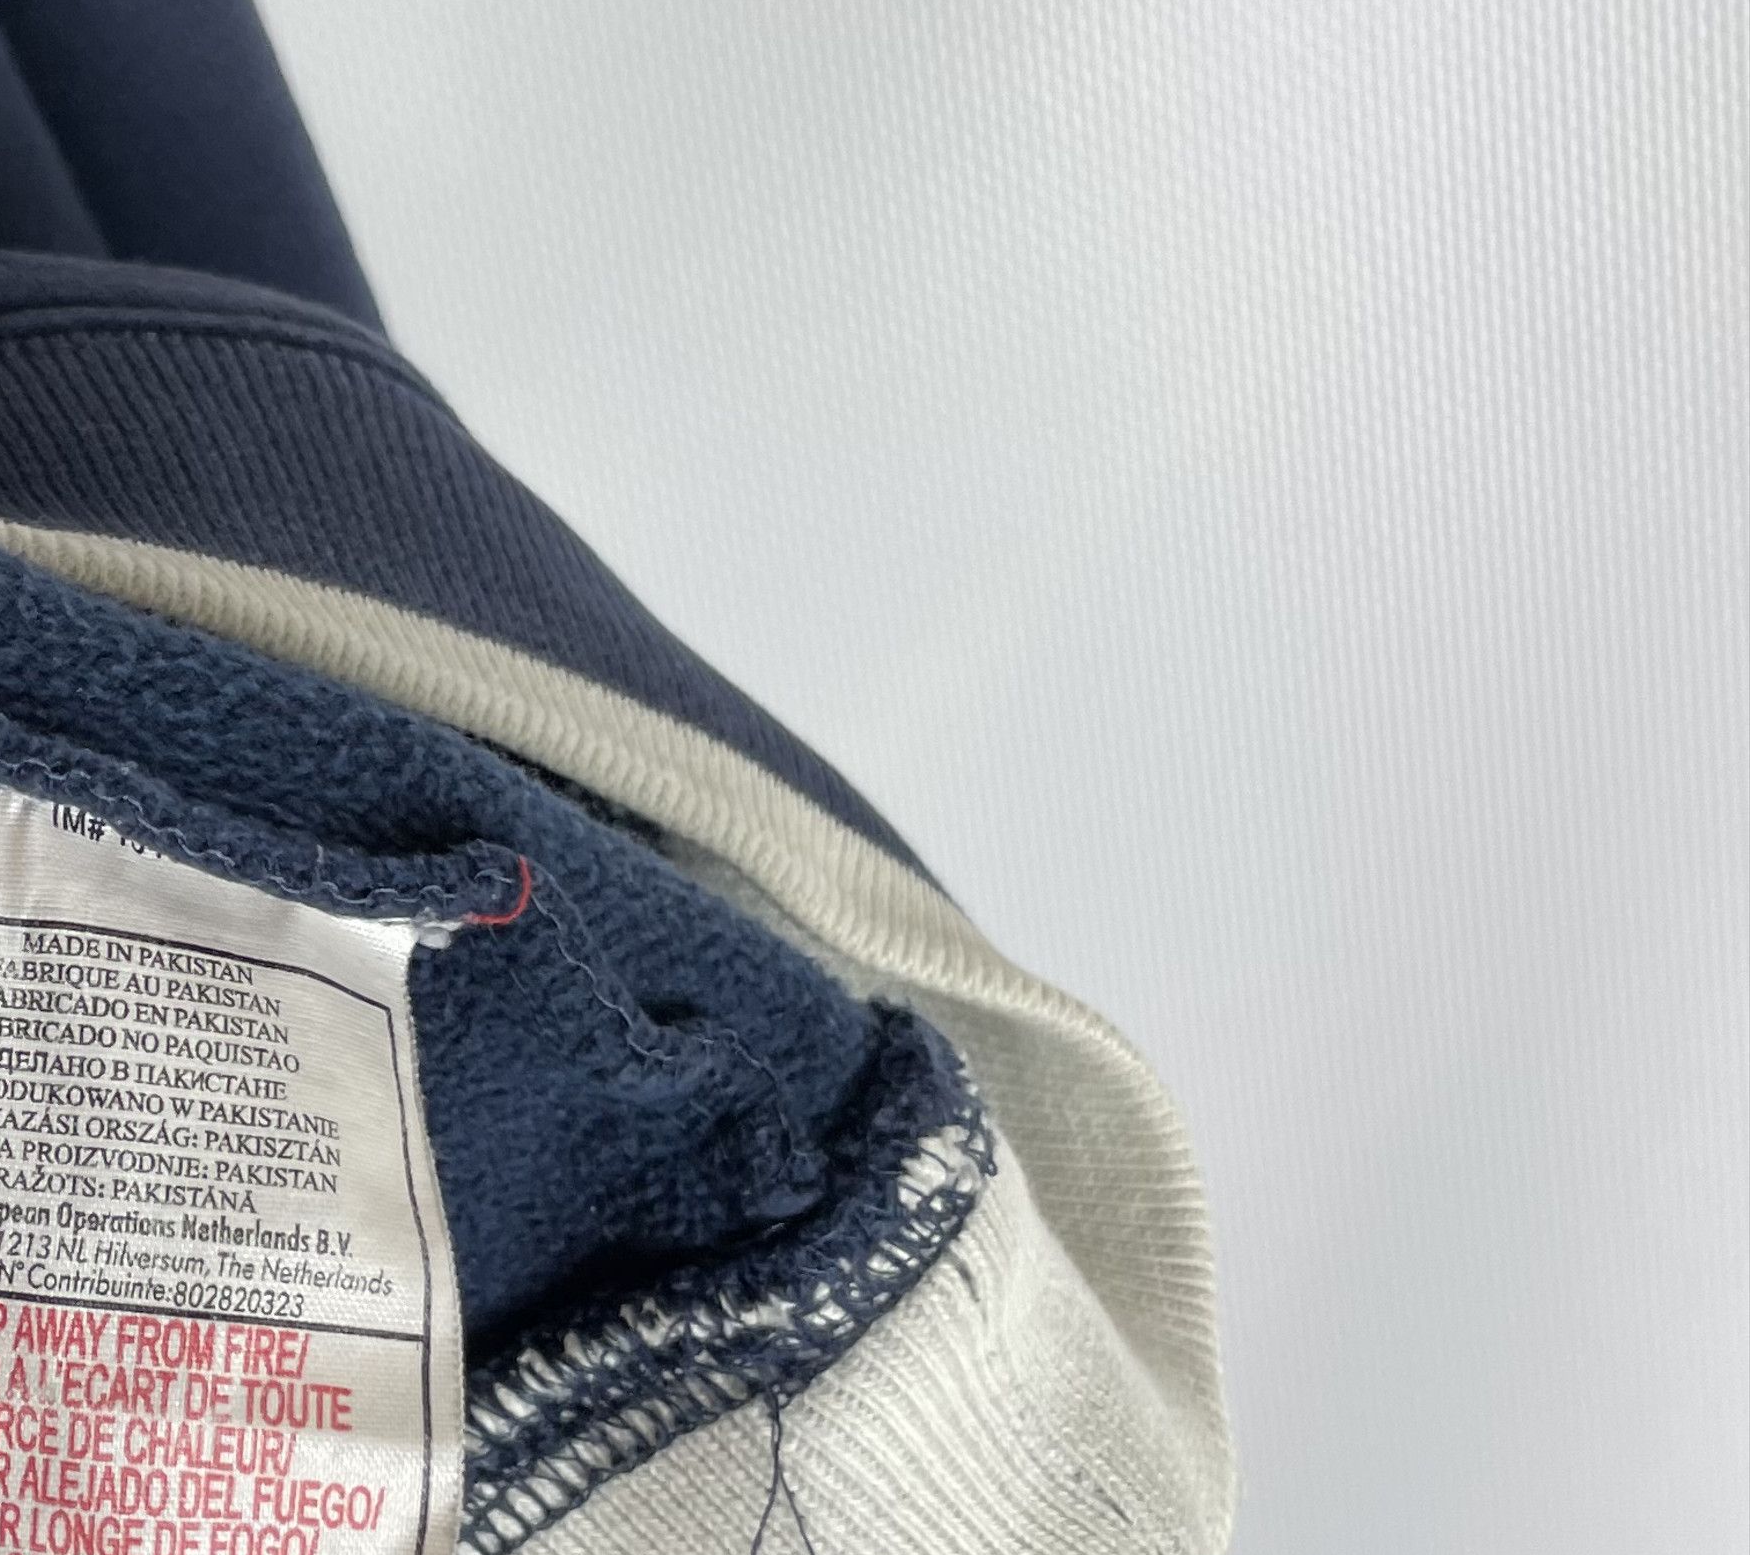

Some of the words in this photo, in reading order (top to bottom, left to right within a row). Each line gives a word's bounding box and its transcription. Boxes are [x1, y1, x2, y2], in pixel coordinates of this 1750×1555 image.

[22, 932, 100, 959] MADE
[106, 941, 133, 963] IN
[138, 946, 253, 986] PAKISTAN
[123, 972, 160, 996] AU
[167, 979, 281, 1017] PAKISTAN
[121, 1028, 159, 1054] NO
[134, 1002, 170, 1026] EN
[173, 1007, 289, 1045] PAKISTAN
[135, 1062, 288, 1101] ПАКИСТАНЕ
[86, 1116, 198, 1148] ORSZÁG:
[204, 1129, 341, 1167] PAKISZTÁN
[170, 1096, 195, 1118] W
[198, 1101, 340, 1140] PAKISTANIE
[22, 1140, 208, 1180] PROIZVODNJE:
[214, 1160, 338, 1194] PAKISTAN
[57, 1201, 176, 1239] Operations
[181, 1213, 310, 1253] Netherlands
[317, 1228, 353, 1258] B.V.
[56, 1237, 87, 1263] NL
[93, 1239, 211, 1278] Hilversum,
[217, 1251, 254, 1280] The
[261, 1256, 395, 1296] Netherlands
[13, 1305, 112, 1361] AWAY
[116, 1315, 216, 1370] FROM
[6, 1355, 30, 1402] A
[38, 1358, 178, 1417] L'ECART
[184, 1373, 234, 1423] DE
[241, 1378, 354, 1432] TOUTE
[67, 1412, 116, 1462] DE
[124, 1417, 297, 1477] CHALEUR/
[18, 1455, 168, 1518] ALEJADO
[177, 1469, 242, 1520] DEL
[252, 1475, 386, 1531] FUEGO/
